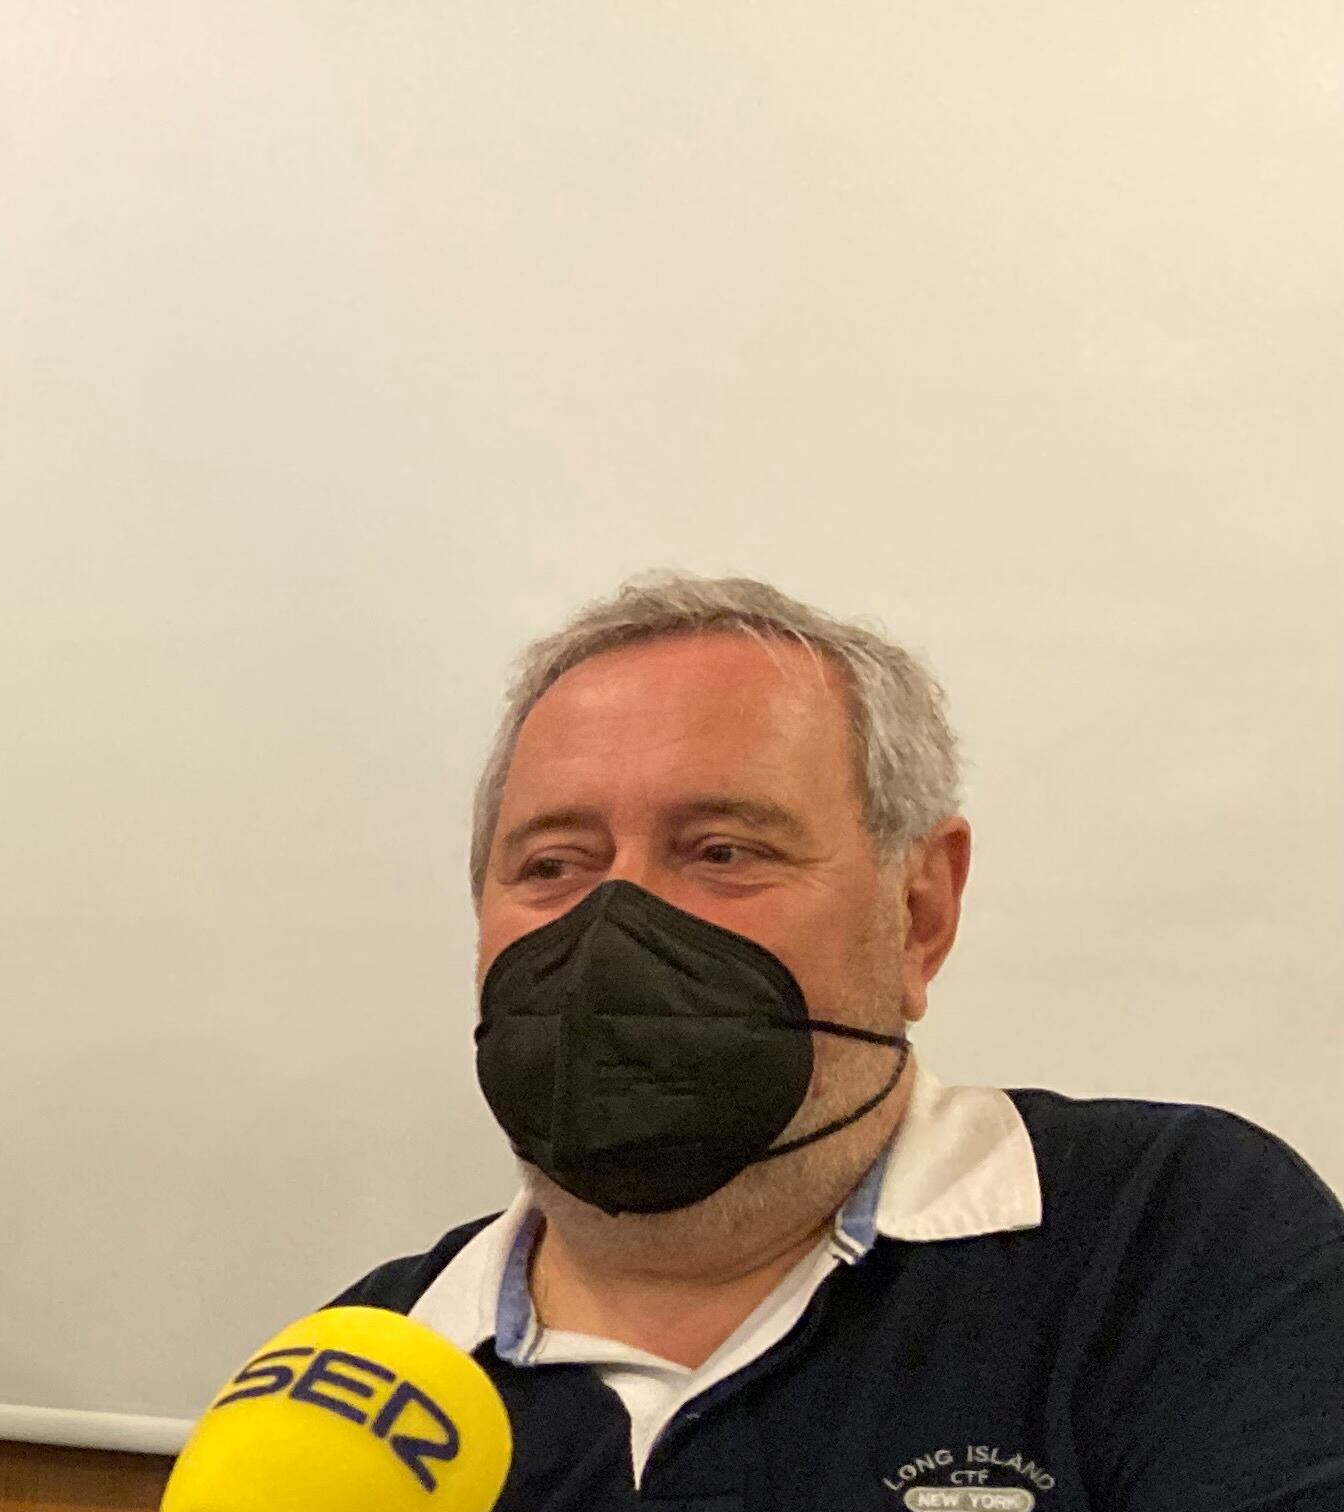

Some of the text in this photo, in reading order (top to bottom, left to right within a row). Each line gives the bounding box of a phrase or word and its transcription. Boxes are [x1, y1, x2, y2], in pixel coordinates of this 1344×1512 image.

[211, 1346, 460, 1494] SER
[882, 1445, 1056, 1492] LONG ISLAND
[917, 1492, 1024, 1510] NEW YORK
